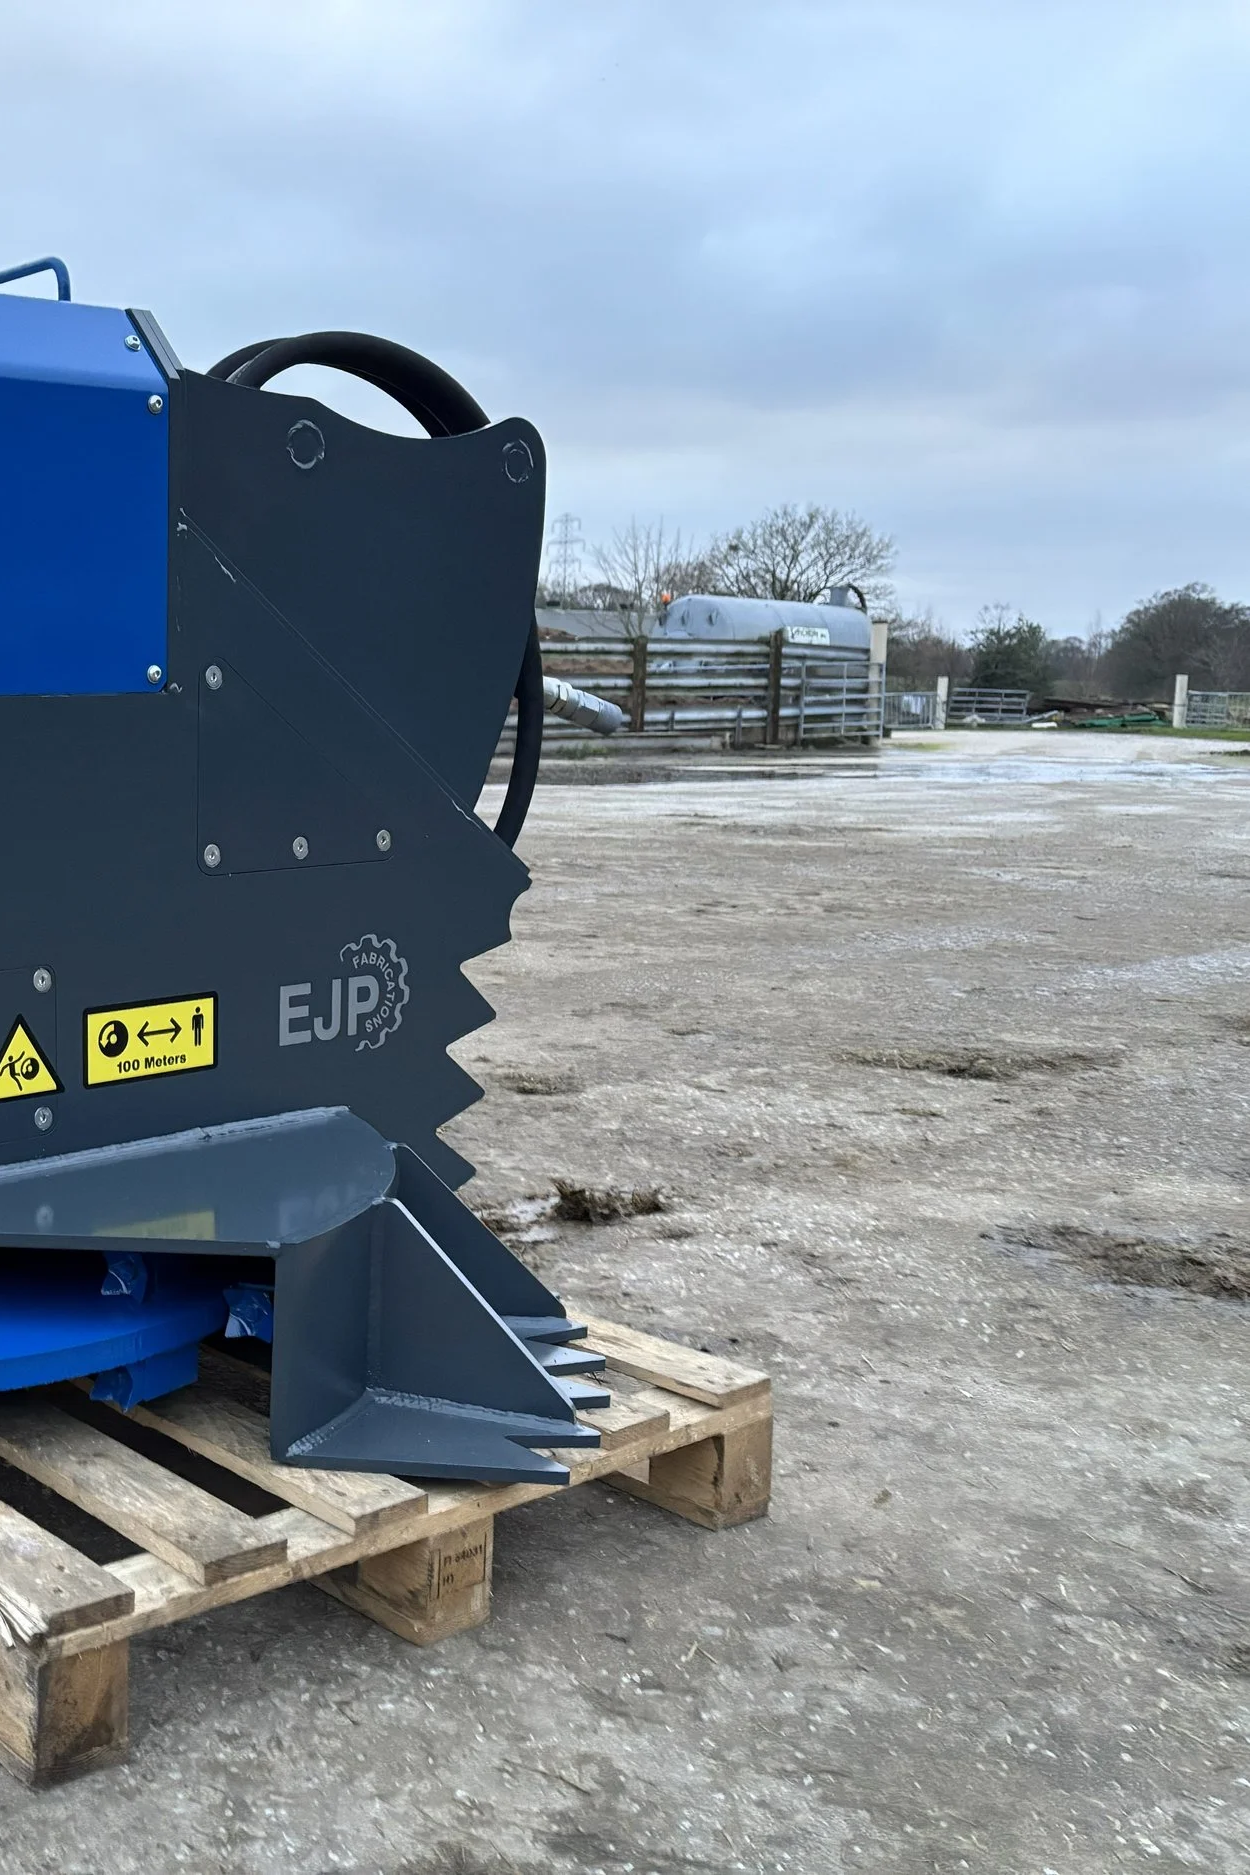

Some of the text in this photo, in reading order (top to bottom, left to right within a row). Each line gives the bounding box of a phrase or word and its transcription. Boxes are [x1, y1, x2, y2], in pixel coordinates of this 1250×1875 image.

[279, 975, 379, 1047] EJP
[352, 952, 396, 1032] FABRICATIONS
[117, 1054, 187, 1073] 100 Meters
